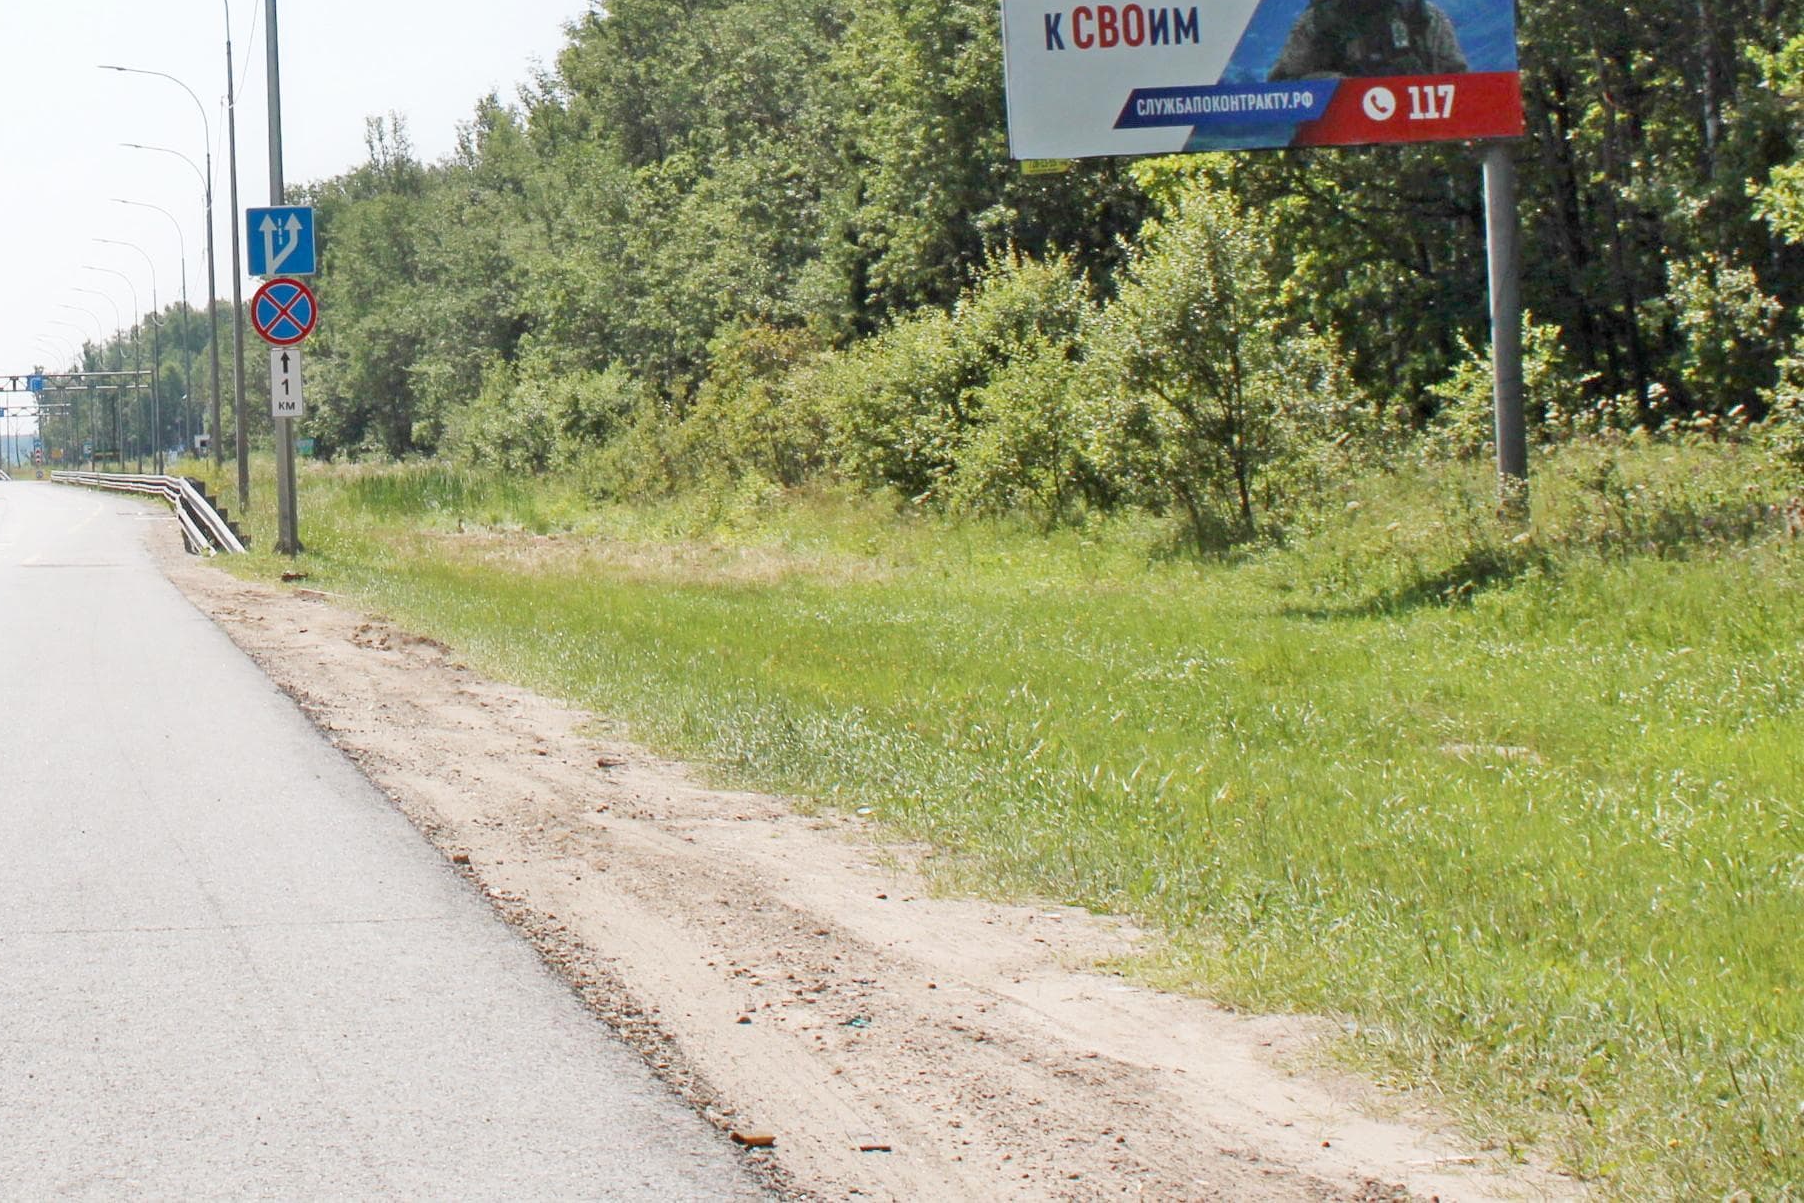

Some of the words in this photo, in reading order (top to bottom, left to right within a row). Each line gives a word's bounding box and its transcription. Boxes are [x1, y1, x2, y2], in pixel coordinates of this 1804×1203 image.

[1136, 91, 1314, 116] СЛУЖБАПОКОНТРАКТУ.РФ
[1407, 84, 1455, 120] 117
[281, 378, 289, 395] 1
